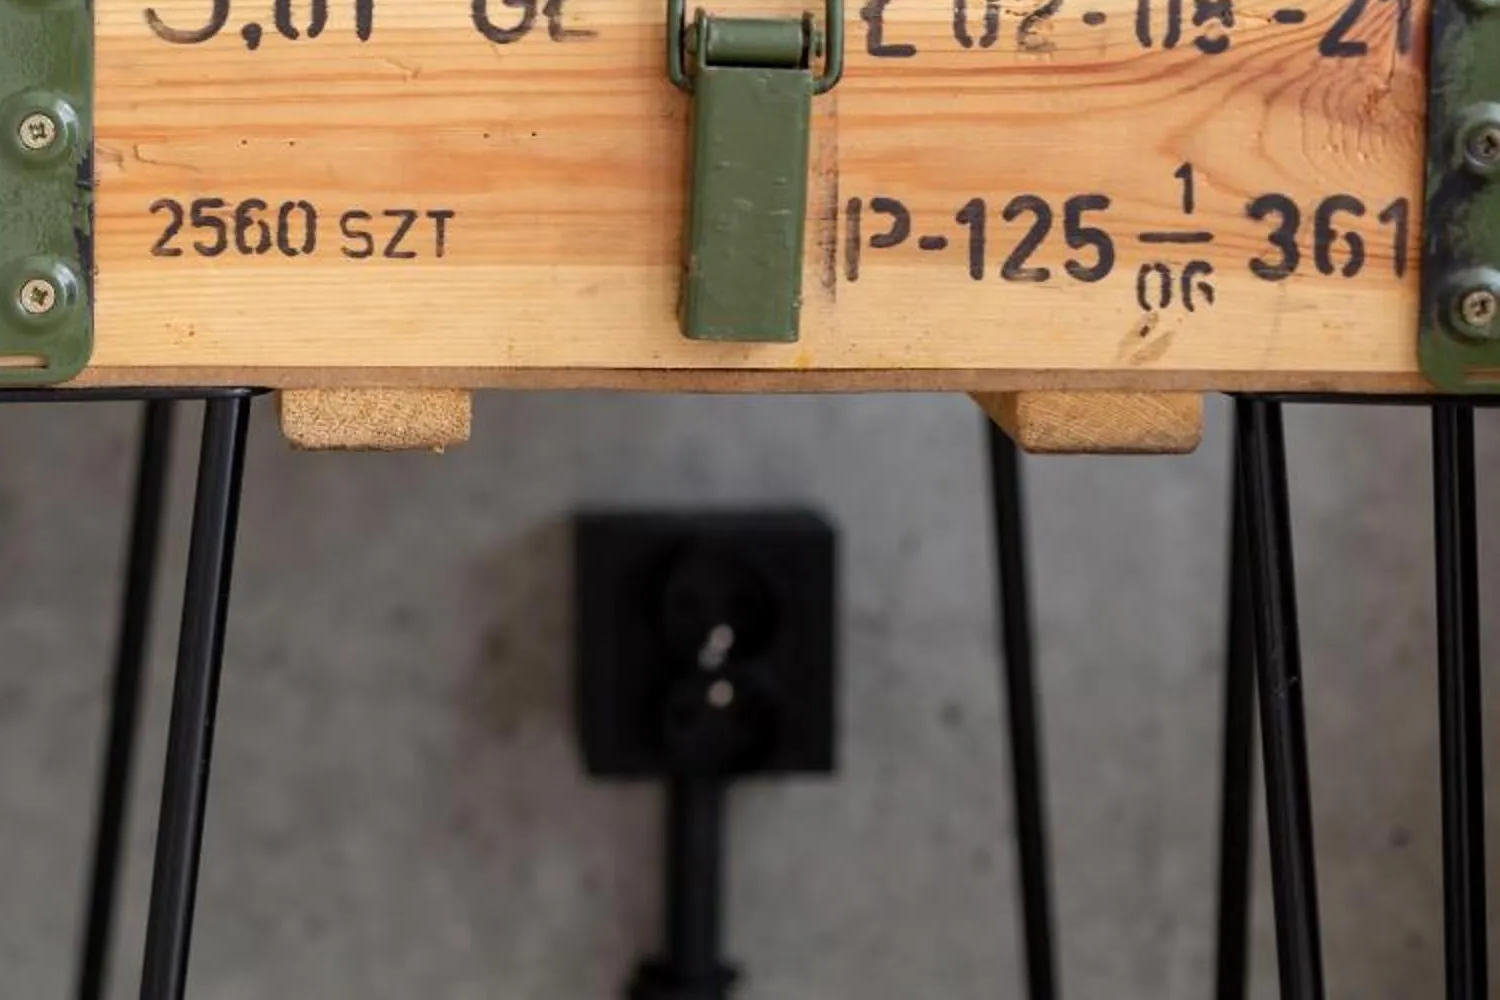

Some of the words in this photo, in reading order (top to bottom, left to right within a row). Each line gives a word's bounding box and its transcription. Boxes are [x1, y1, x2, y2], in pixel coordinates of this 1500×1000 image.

[148, 198, 317, 257] 2560
[339, 211, 455, 258] SZT
[1244, 193, 1409, 281] 361
[1137, 260, 1215, 312] 06
